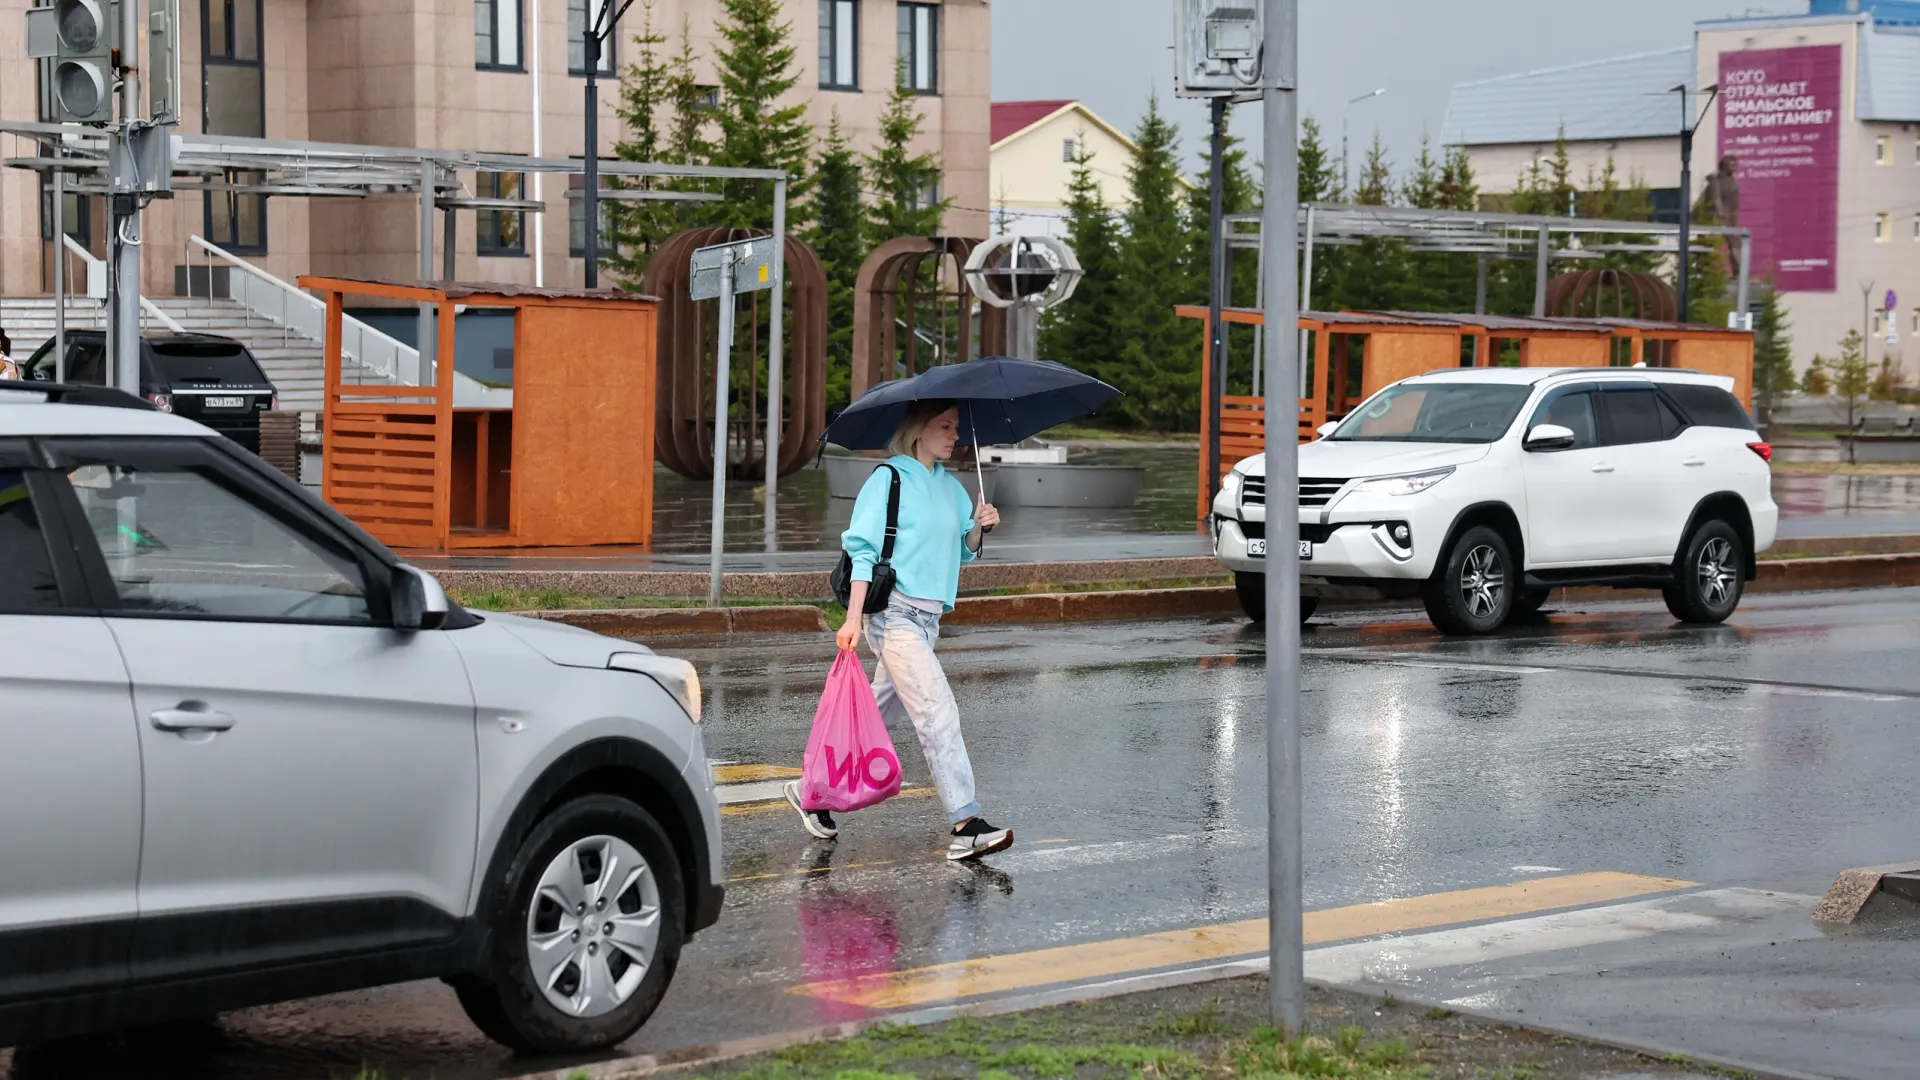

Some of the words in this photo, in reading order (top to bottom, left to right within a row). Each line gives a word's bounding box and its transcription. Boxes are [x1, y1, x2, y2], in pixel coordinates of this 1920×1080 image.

[1725, 69, 1766, 84] КОГО
[1725, 81, 1808, 99] ОТРАЖАЕТ
[1725, 95, 1815, 113] ЯМАЛЬСКОЕ
[1724, 109, 1833, 128] ВОСПИТАНИЕ?
